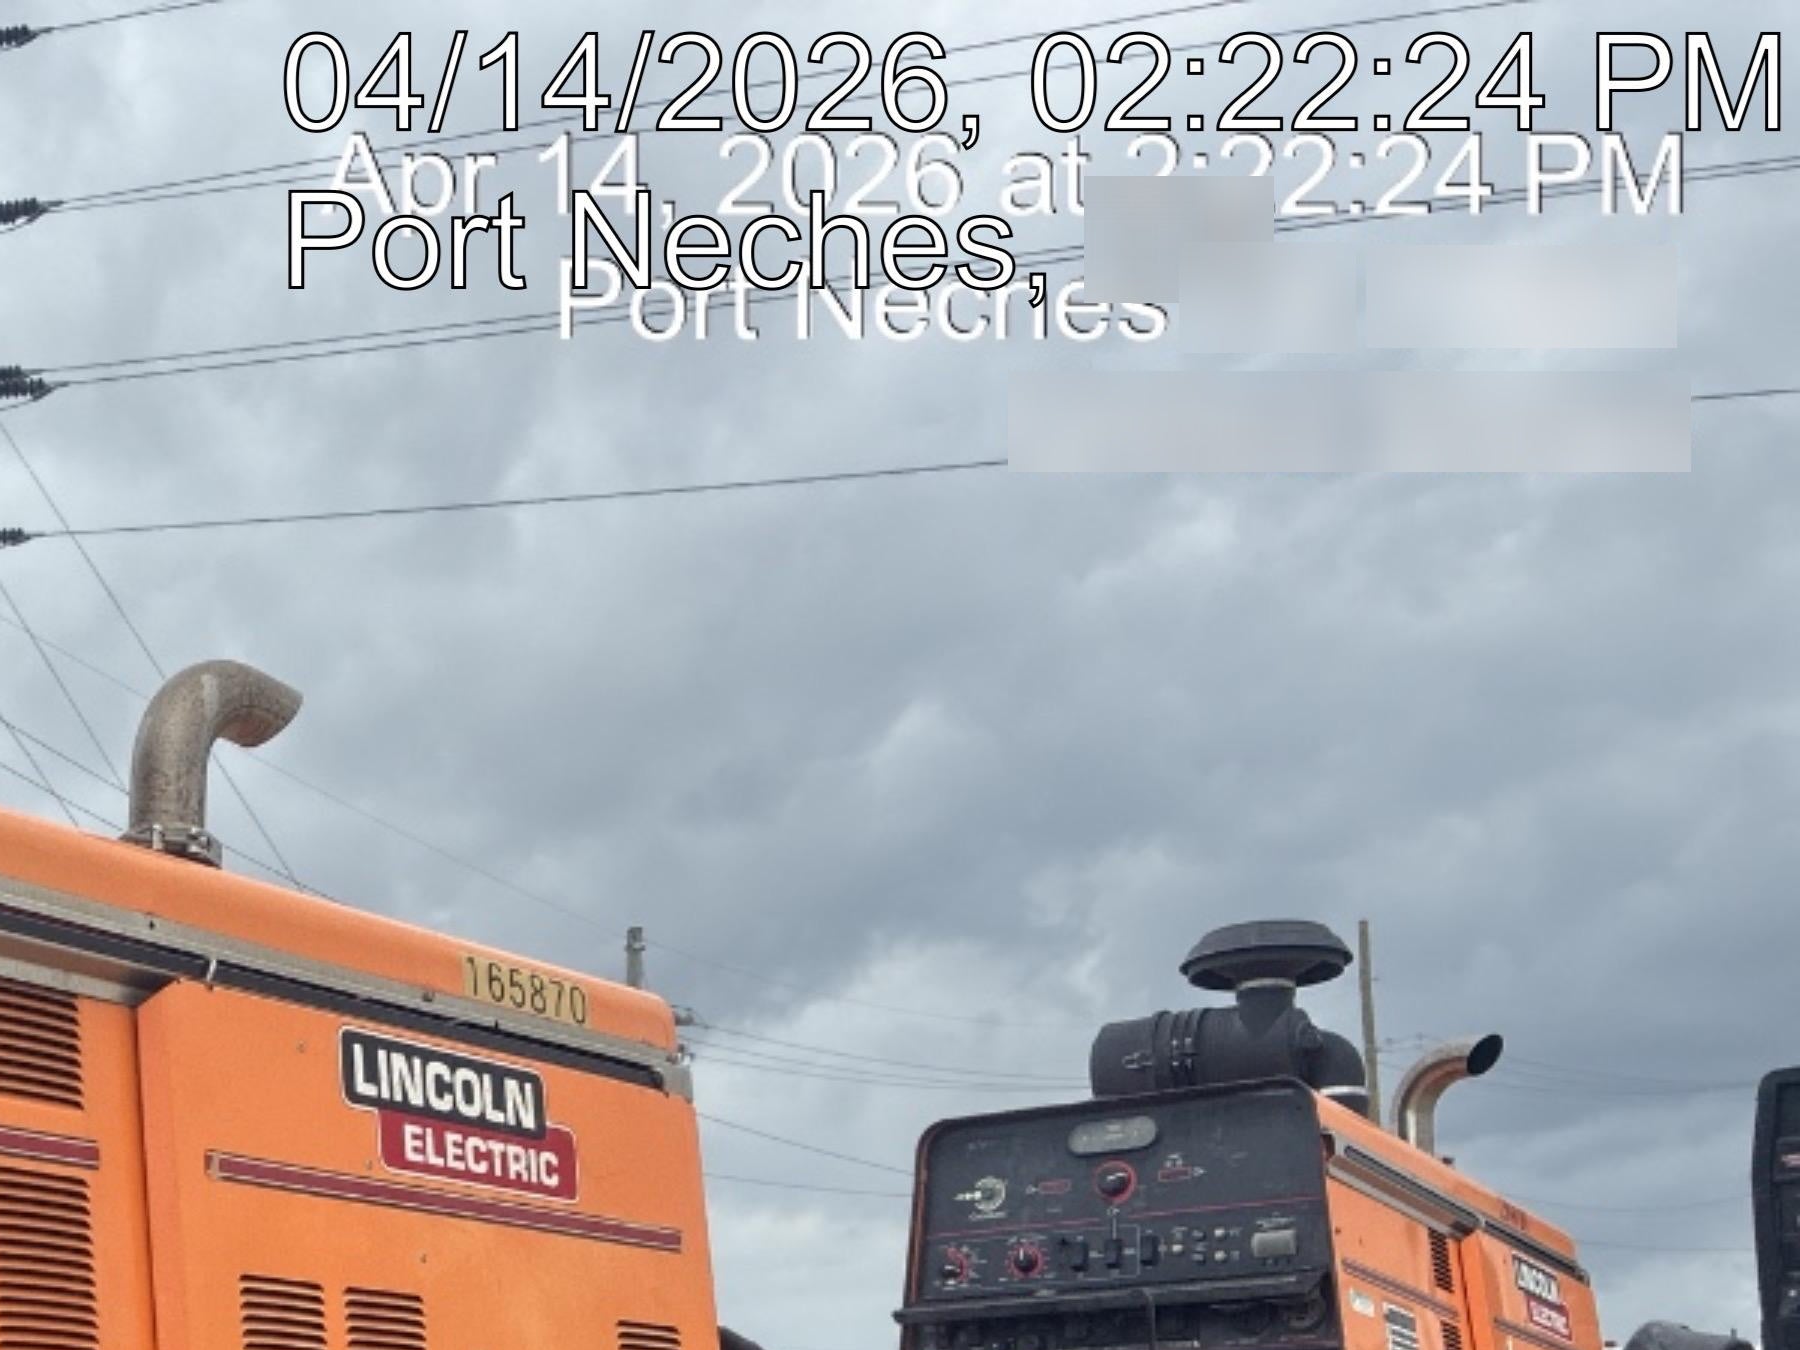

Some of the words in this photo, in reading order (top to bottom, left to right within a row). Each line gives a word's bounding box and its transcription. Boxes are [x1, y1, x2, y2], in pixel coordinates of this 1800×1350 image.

[464, 955, 588, 1025] 165870
[352, 1041, 537, 1131] LINCOLN
[403, 1124, 561, 1188] ELECTRIC
